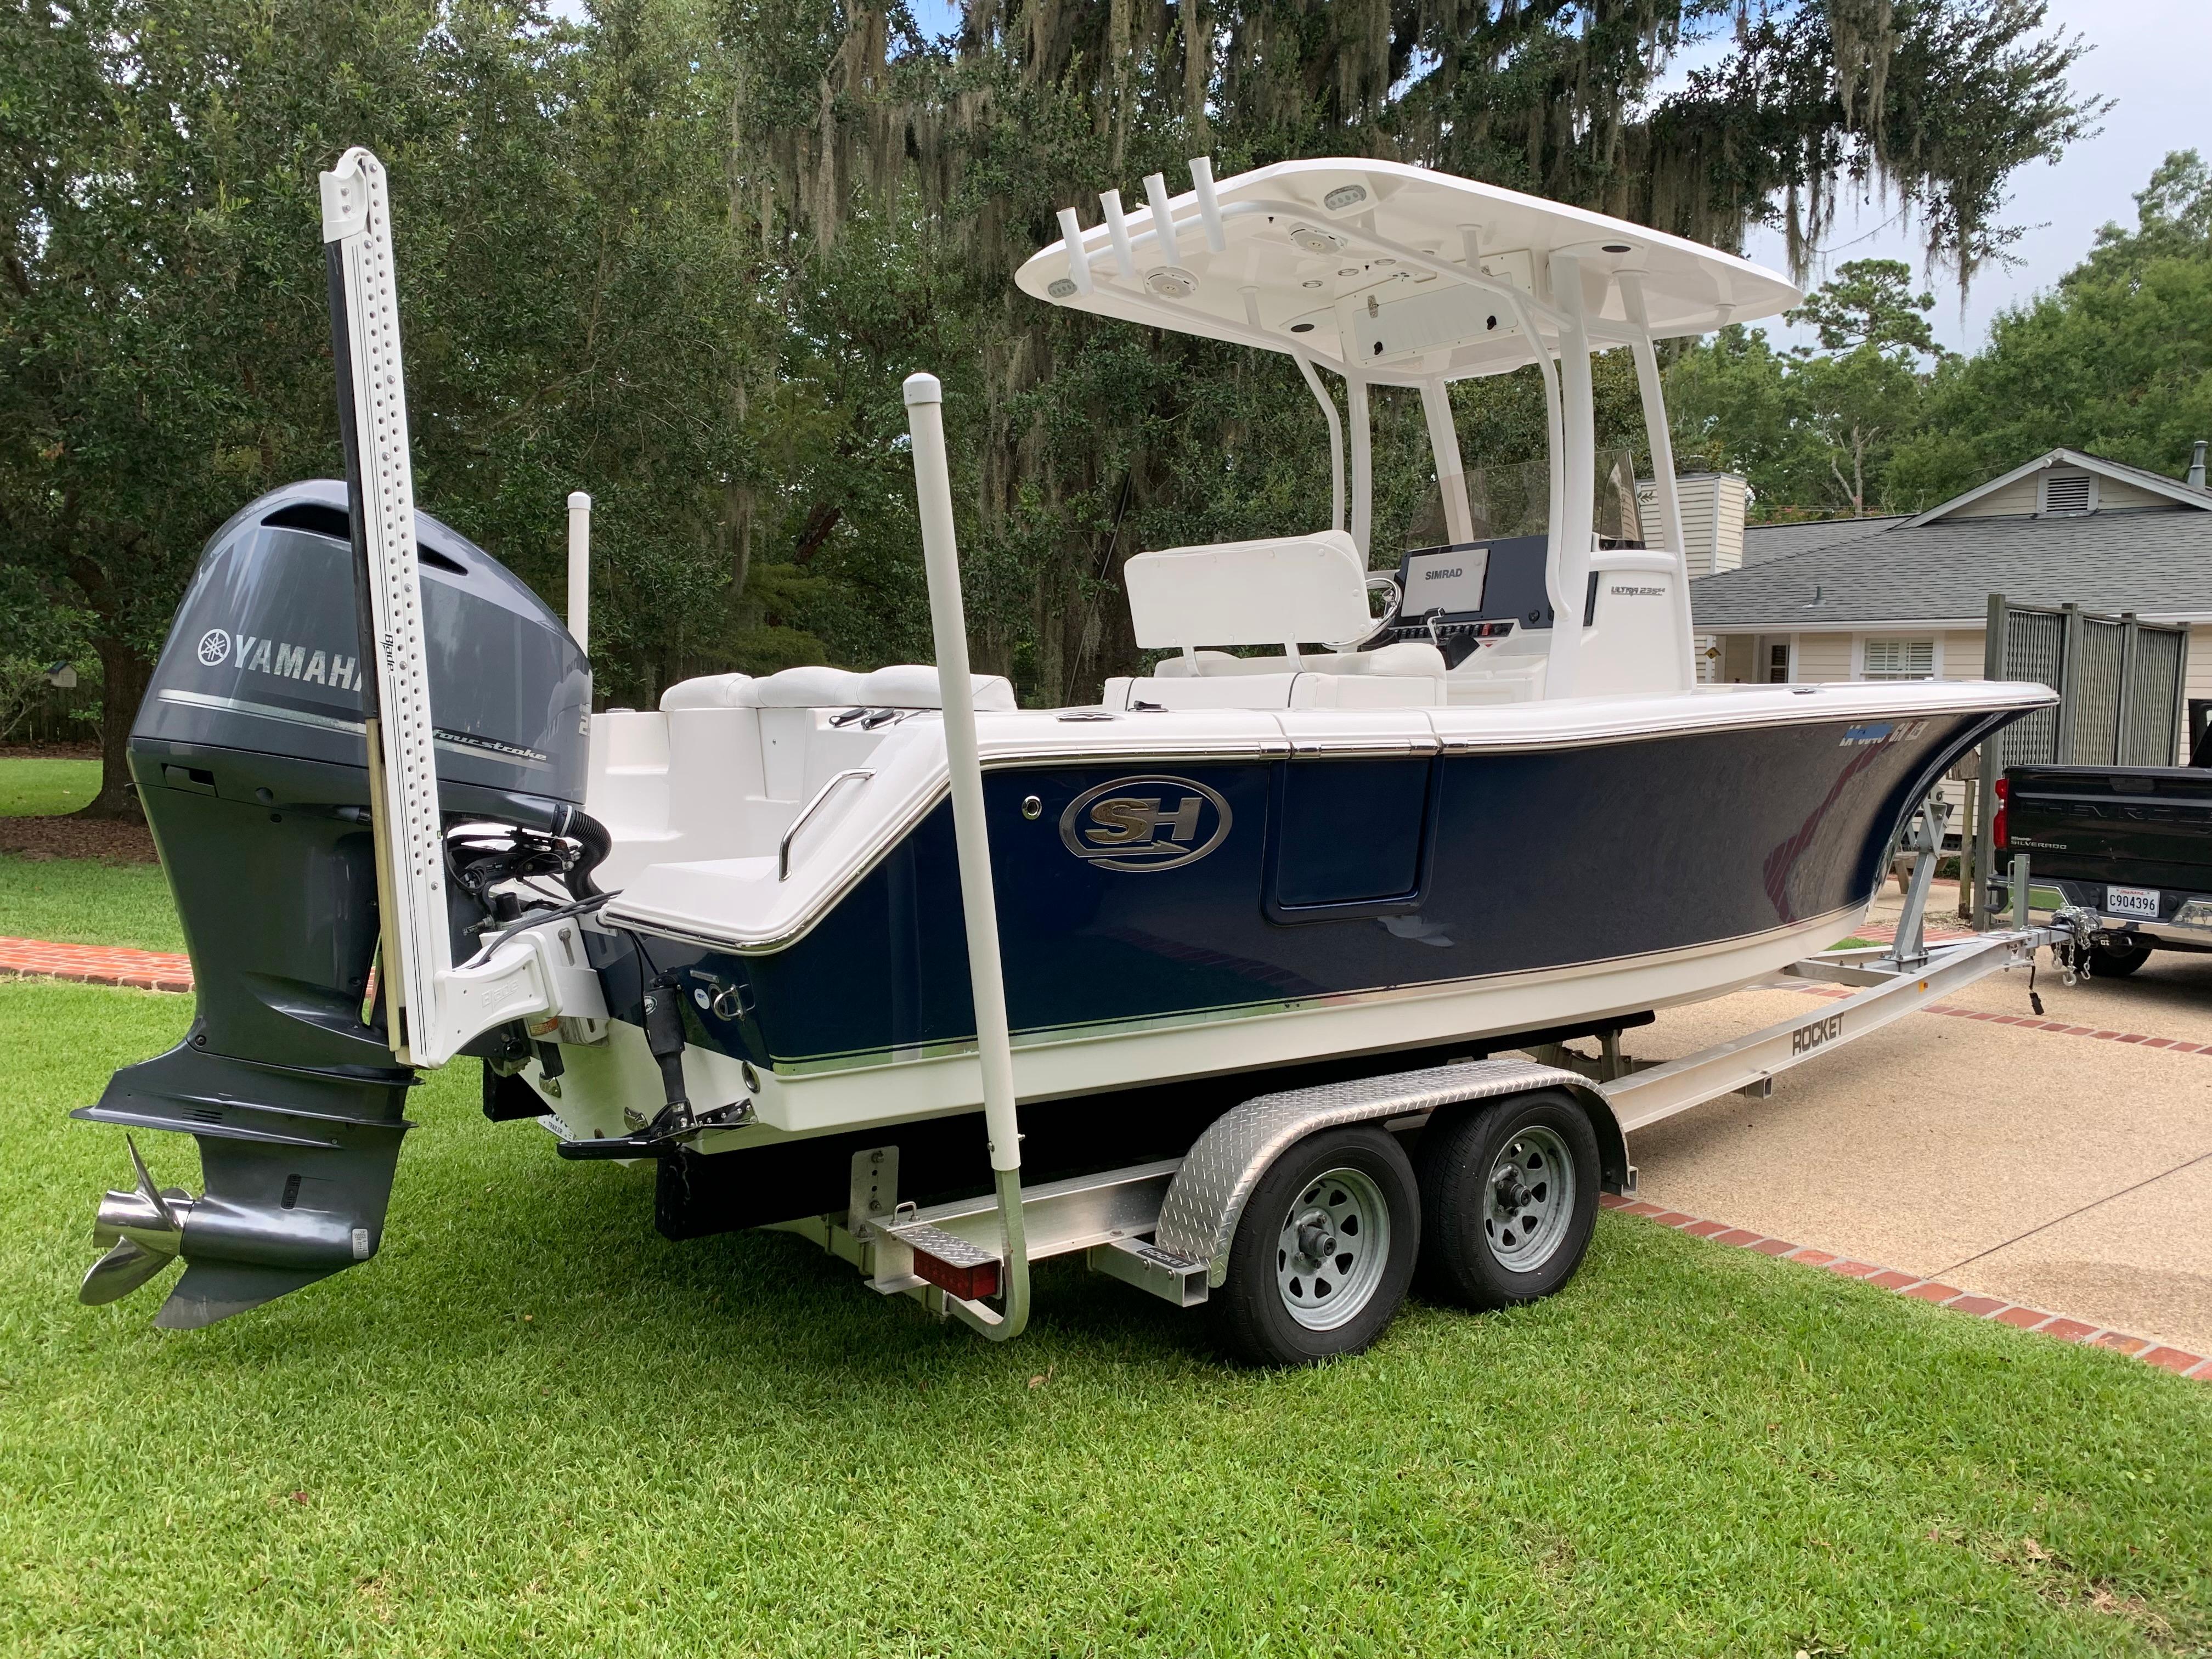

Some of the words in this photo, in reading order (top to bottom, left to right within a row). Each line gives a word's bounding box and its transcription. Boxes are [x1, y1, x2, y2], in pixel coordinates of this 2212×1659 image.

[1425, 568, 1463, 580] SIMRAD
[379, 634, 395, 672] Blade
[481, 742, 547, 761] stroke
[1085, 797, 1203, 844] SH
[2010, 840, 2067, 850] SILVERADO
[2110, 894, 2155, 911] C904396
[1792, 1012, 1844, 1056] ROCKET
[1142, 1248, 1189, 1267] ROCKET
